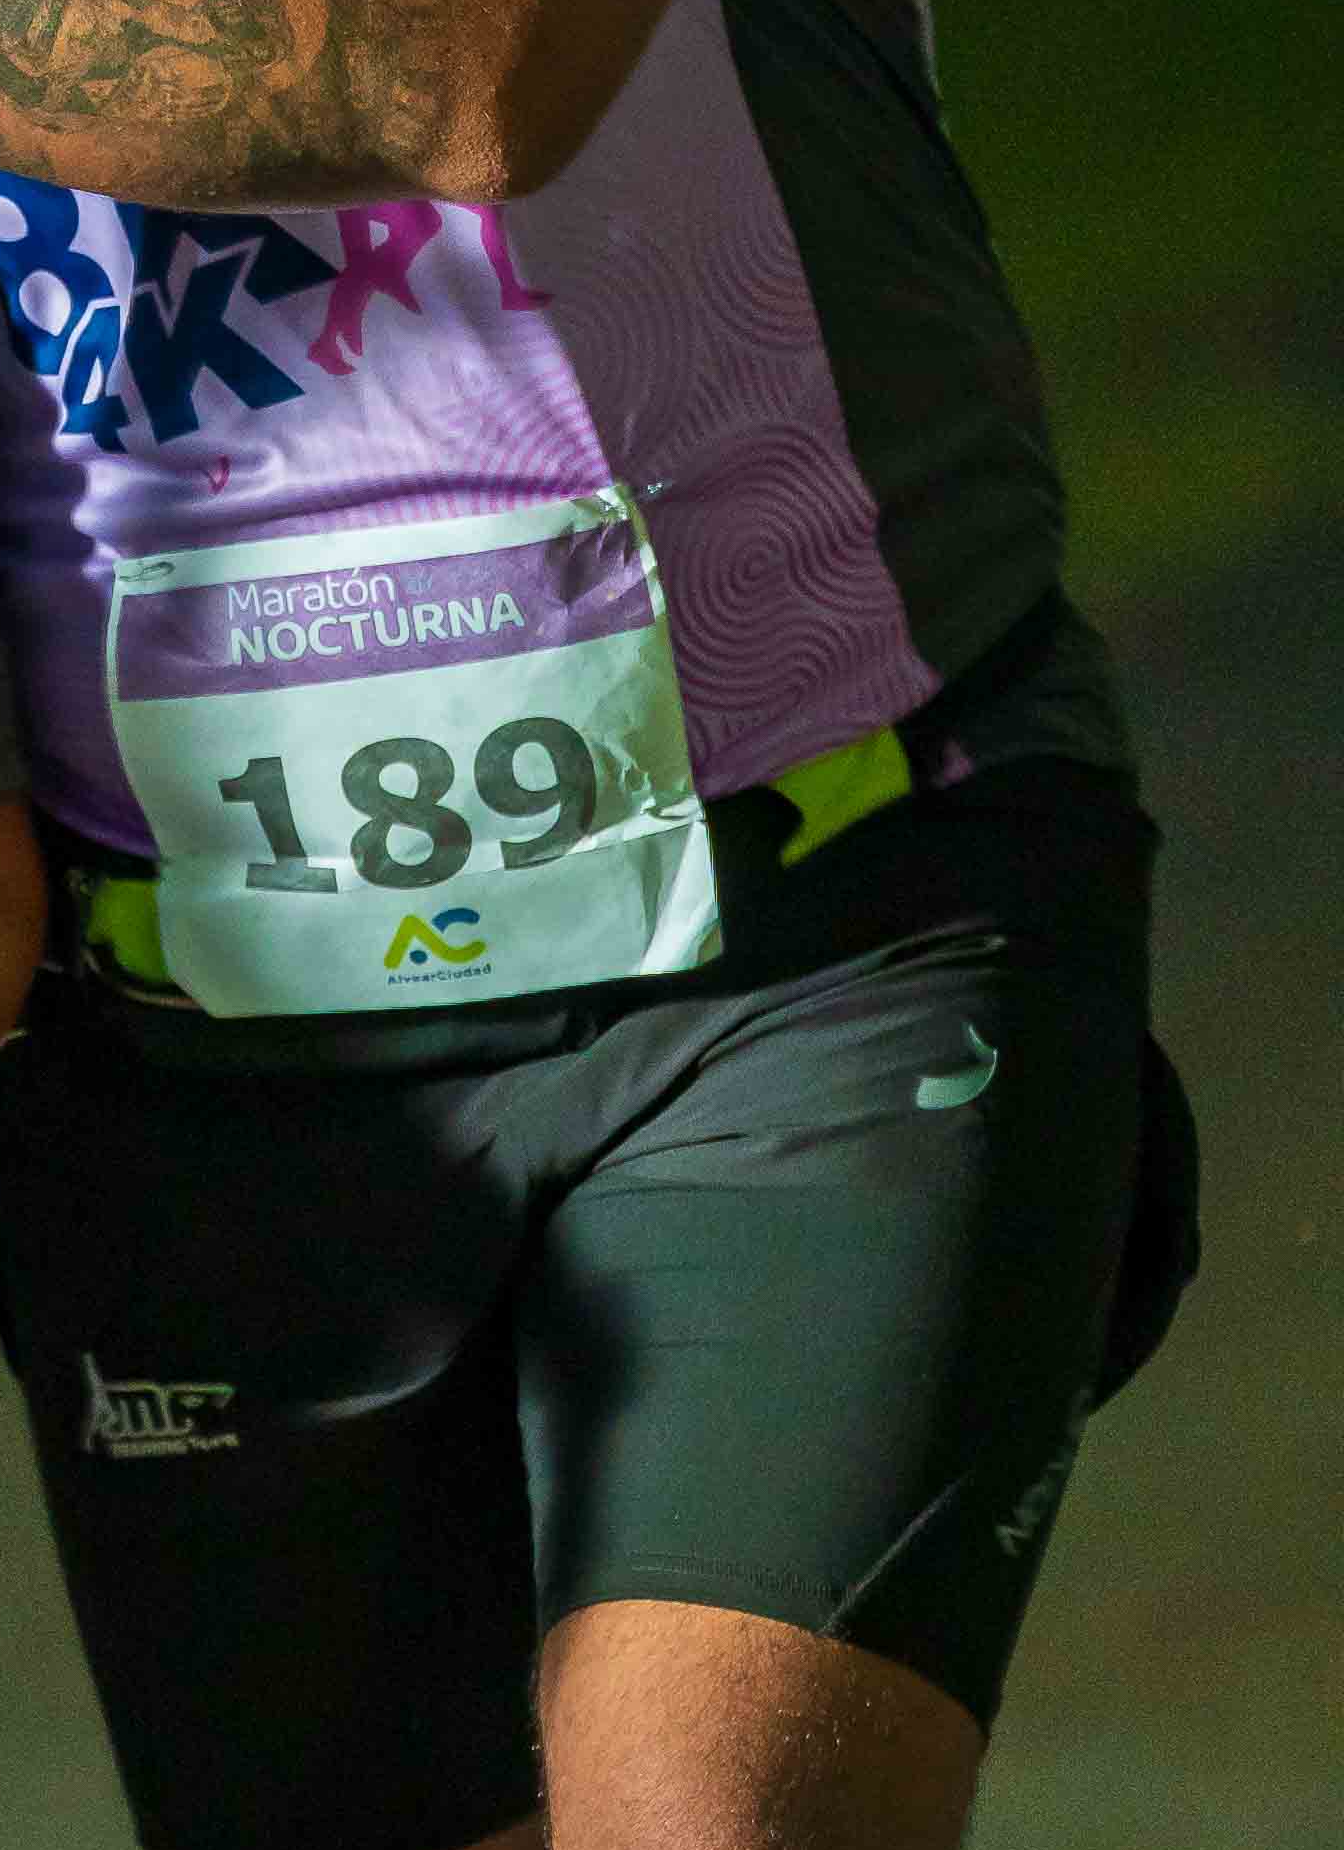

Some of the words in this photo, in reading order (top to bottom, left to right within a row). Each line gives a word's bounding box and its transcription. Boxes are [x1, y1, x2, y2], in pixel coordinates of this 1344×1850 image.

[226, 565, 396, 621] Maratón
[230, 592, 526, 664] NOCTURNA
[218, 716, 597, 895] 189
